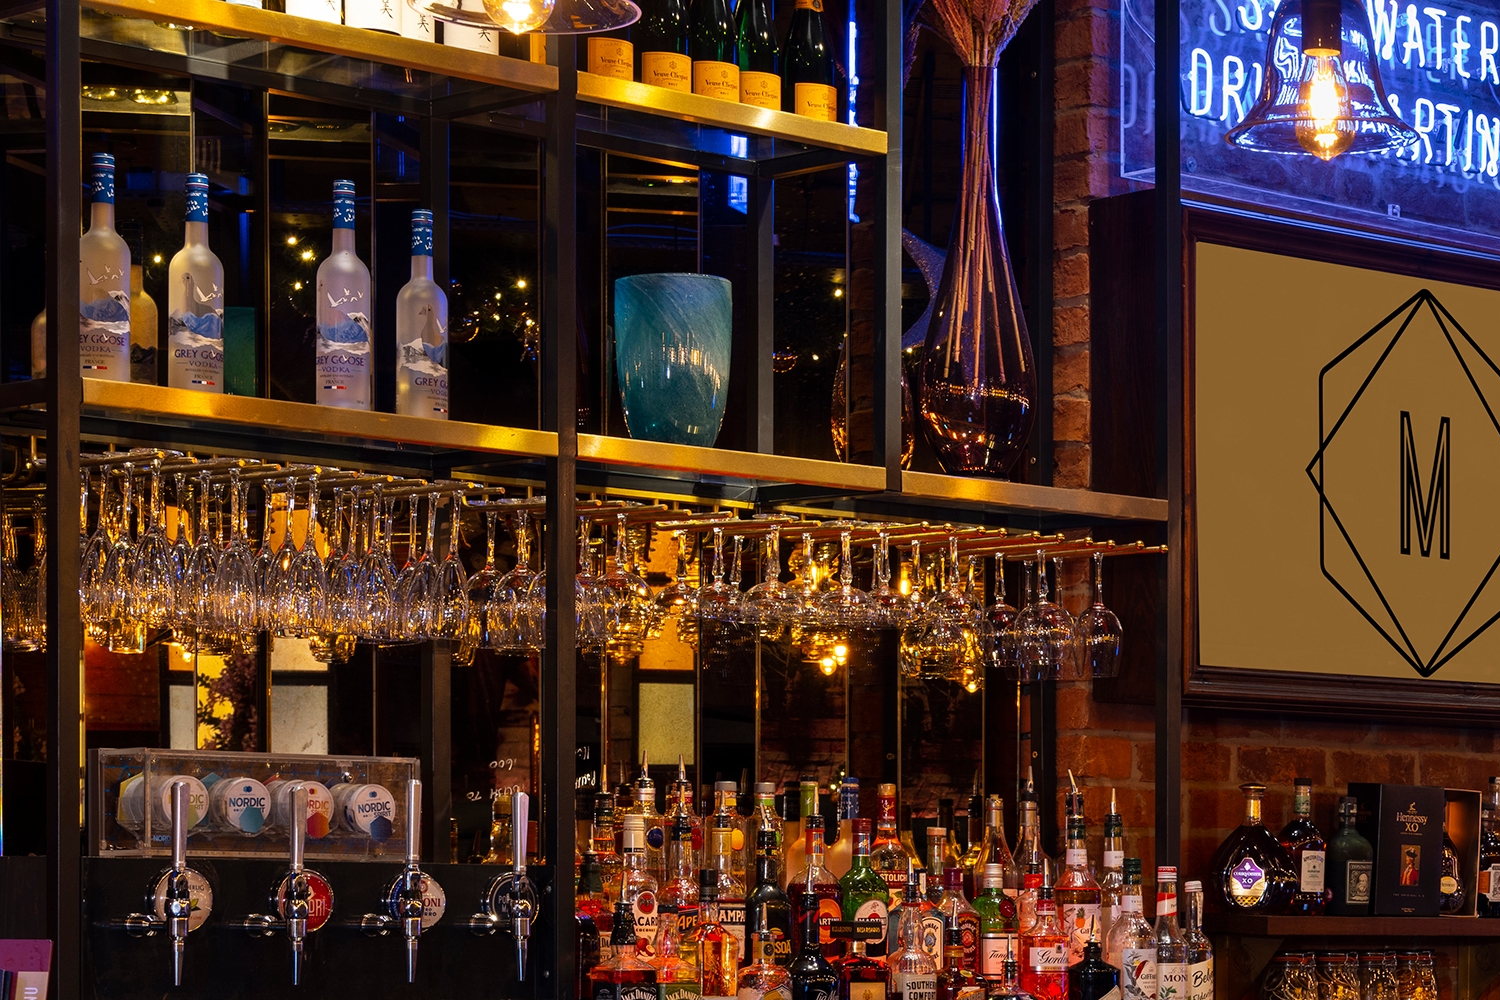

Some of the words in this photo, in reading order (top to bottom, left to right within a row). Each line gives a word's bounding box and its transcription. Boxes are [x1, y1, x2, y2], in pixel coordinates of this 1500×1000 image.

[653, 70, 670, 78] Veuve
[91, 333, 125, 347] GOOSE
[80, 345, 111, 353] VODKA
[174, 349, 197, 359] GREY
[201, 349, 224, 362] GOOS
[331, 355, 365, 367] GOOSE
[188, 360, 218, 370] VODKA
[321, 366, 351, 374] VODKA
[414, 377, 439, 388] GREY
[1400, 410, 1451, 560] M
[228, 797, 266, 808] NORDIC
[357, 801, 391, 814] NORDIC
[1396, 811, 1429, 826] Hennessy
[880, 874, 908, 883] STOLICH
[422, 898, 441, 908] ONI
[308, 904, 327, 917] DRI
[718, 908, 746, 923] AMPA
[676, 913, 698, 931] APE
[1163, 974, 1188, 983] MON
[906, 980, 936, 991] SOUTHER
